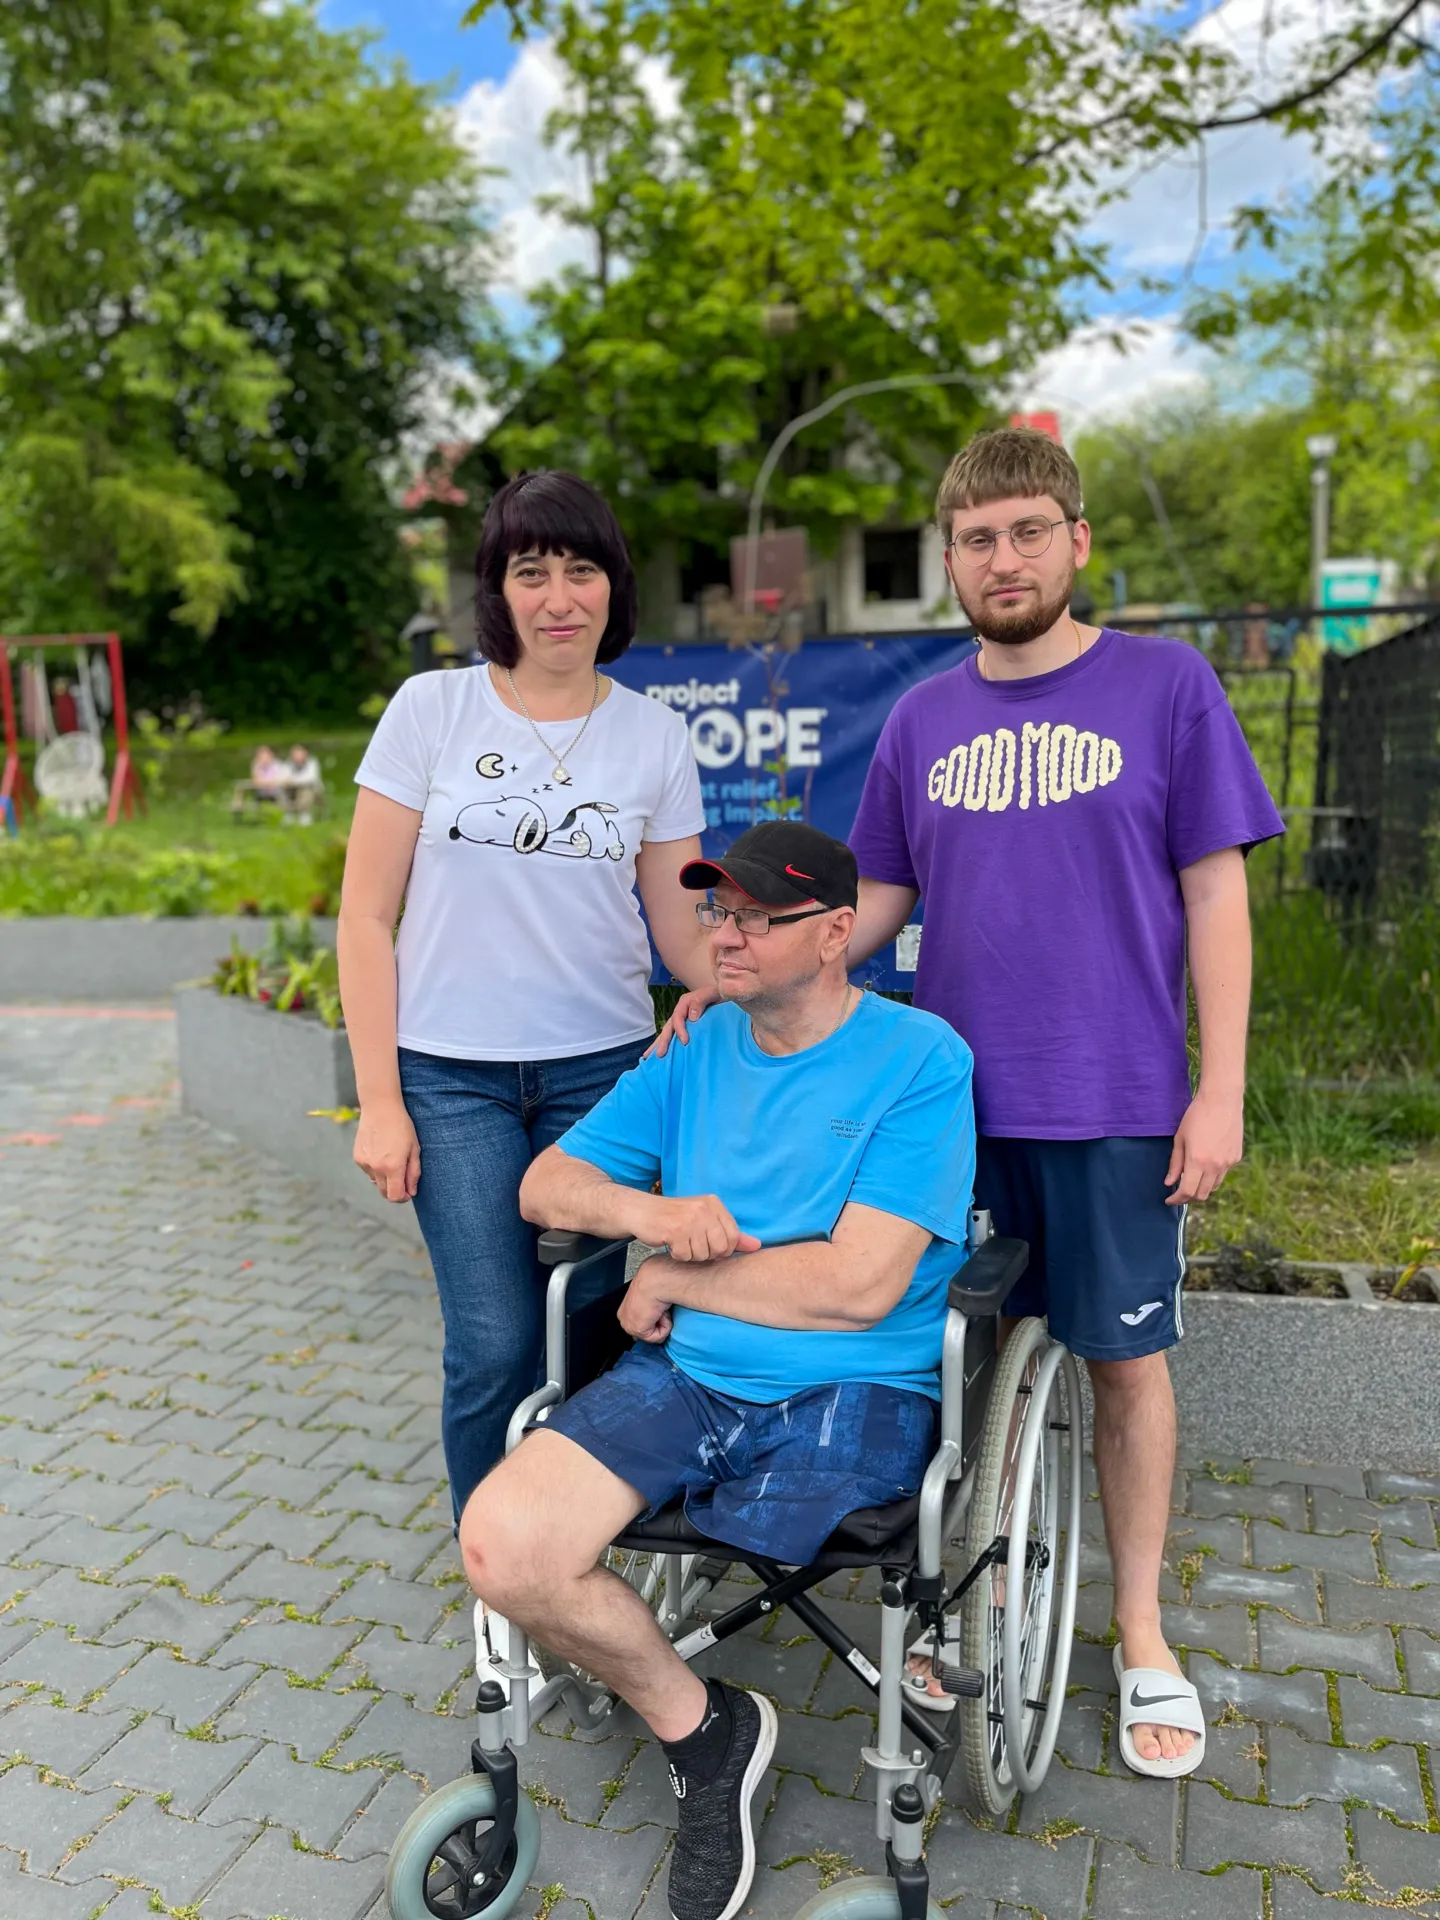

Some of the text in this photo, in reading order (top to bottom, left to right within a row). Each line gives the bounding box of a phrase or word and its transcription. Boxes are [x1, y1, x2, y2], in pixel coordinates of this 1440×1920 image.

[645, 678, 740, 711] project
[675, 708, 823, 769] OPE
[927, 721, 1123, 812] GOOD MOOD
[724, 802, 804, 826] impat.
